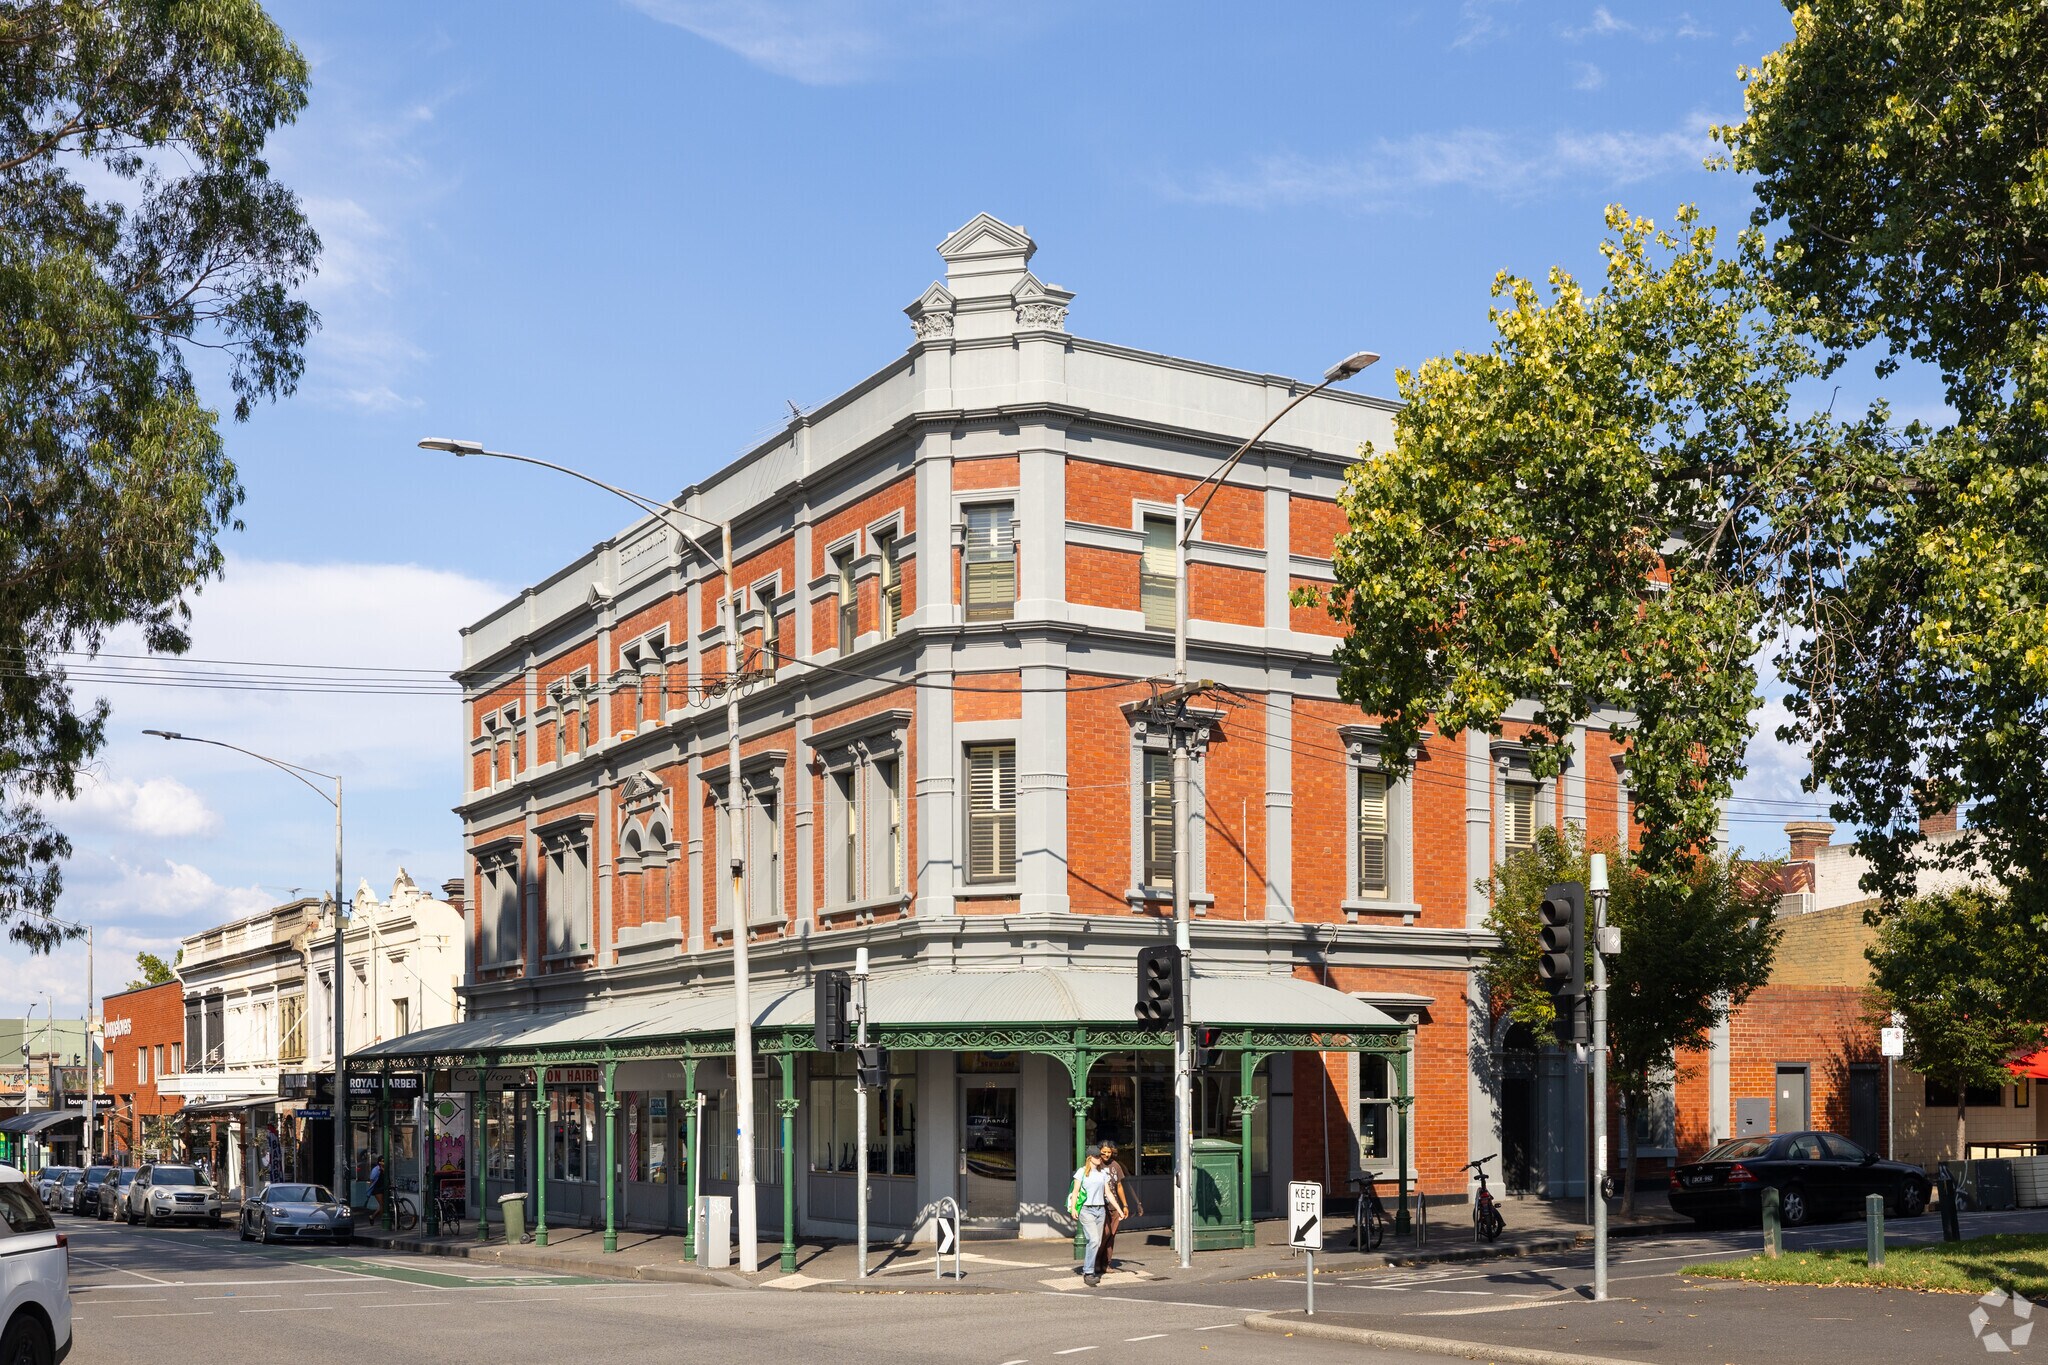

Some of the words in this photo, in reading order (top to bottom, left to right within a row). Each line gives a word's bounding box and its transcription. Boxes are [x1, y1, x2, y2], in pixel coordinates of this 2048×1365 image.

[455, 1070, 512, 1081] Calton
[349, 1078, 378, 1088] ROYAL
[1295, 1188, 1317, 1199] KEEP
[1296, 1202, 1316, 1212] LEFT
